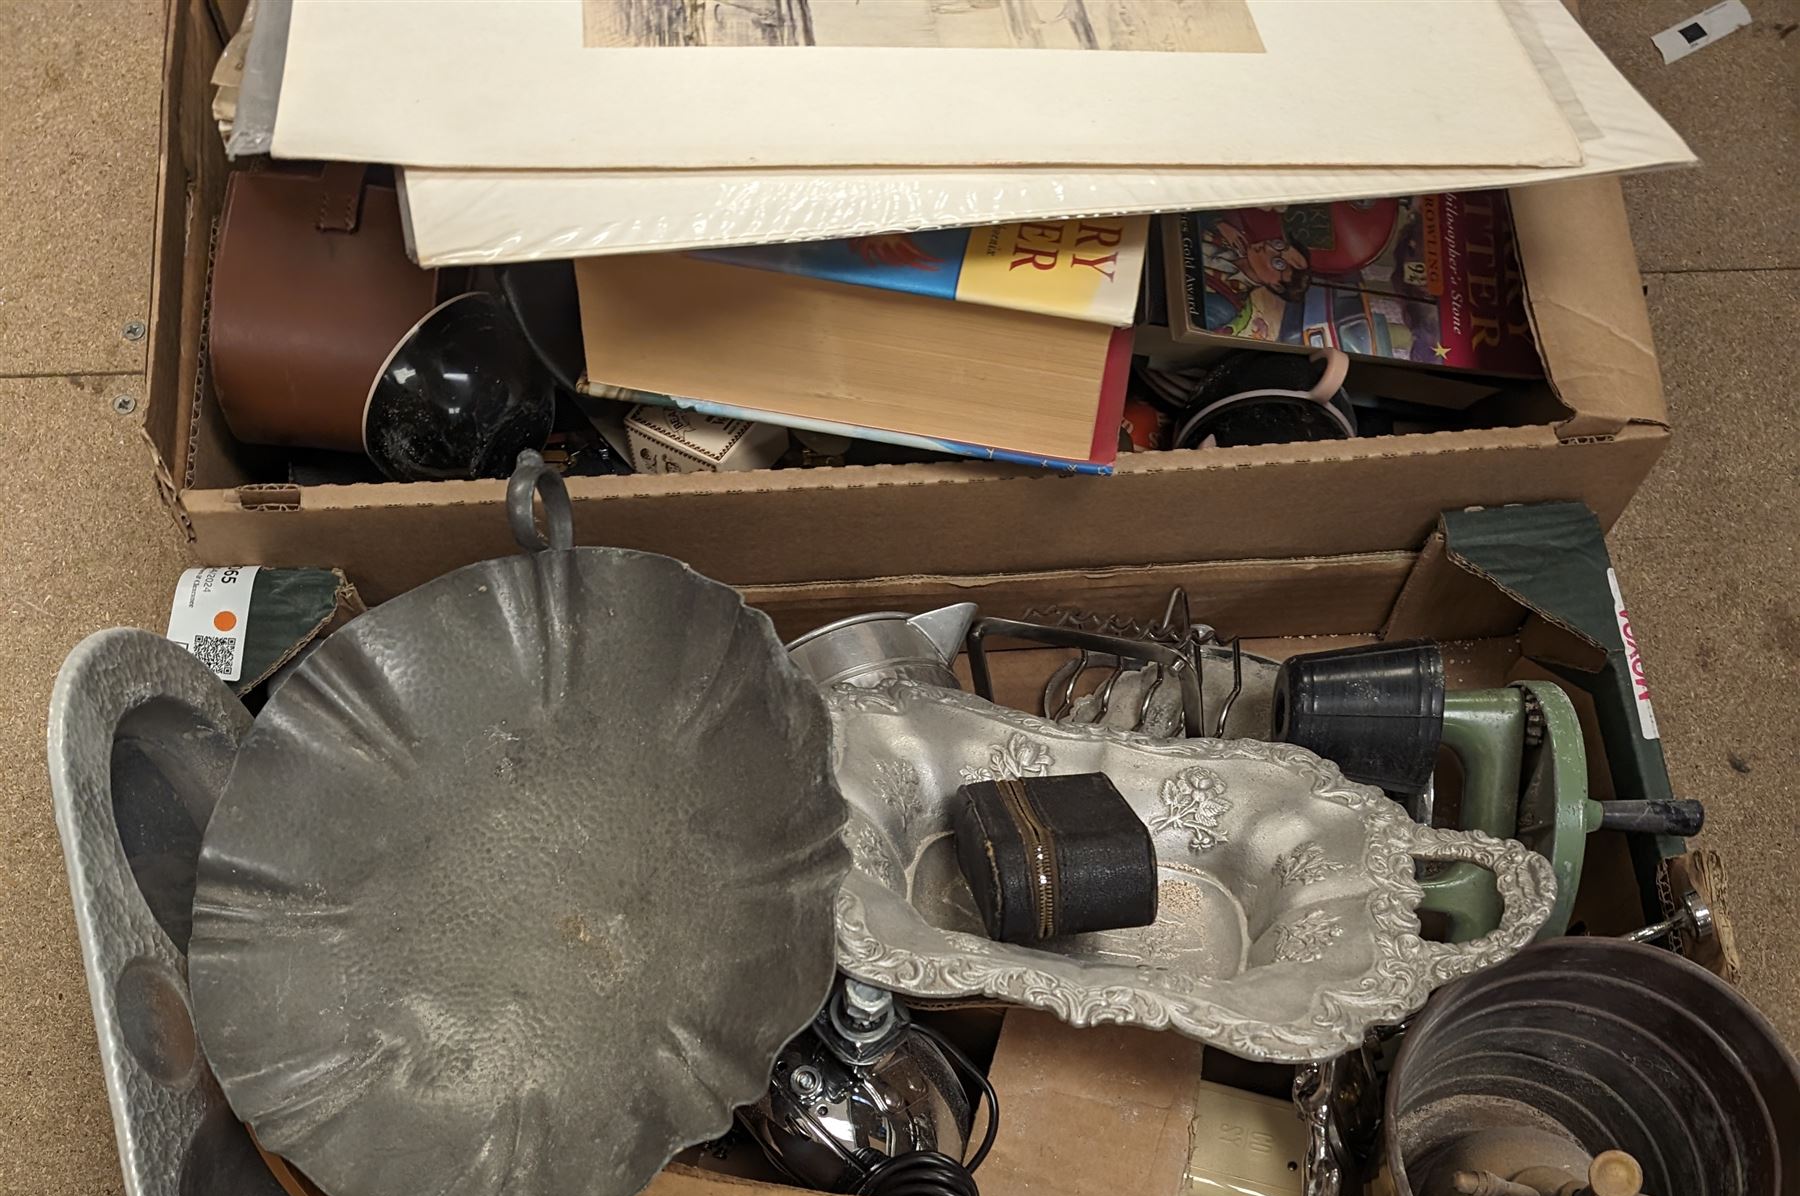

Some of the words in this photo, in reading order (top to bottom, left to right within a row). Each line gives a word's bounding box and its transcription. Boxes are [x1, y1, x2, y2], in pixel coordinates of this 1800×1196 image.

[1183, 237, 1196, 269] Gold
[1185, 273, 1200, 316] Award
[1451, 289, 1464, 335] Stone
